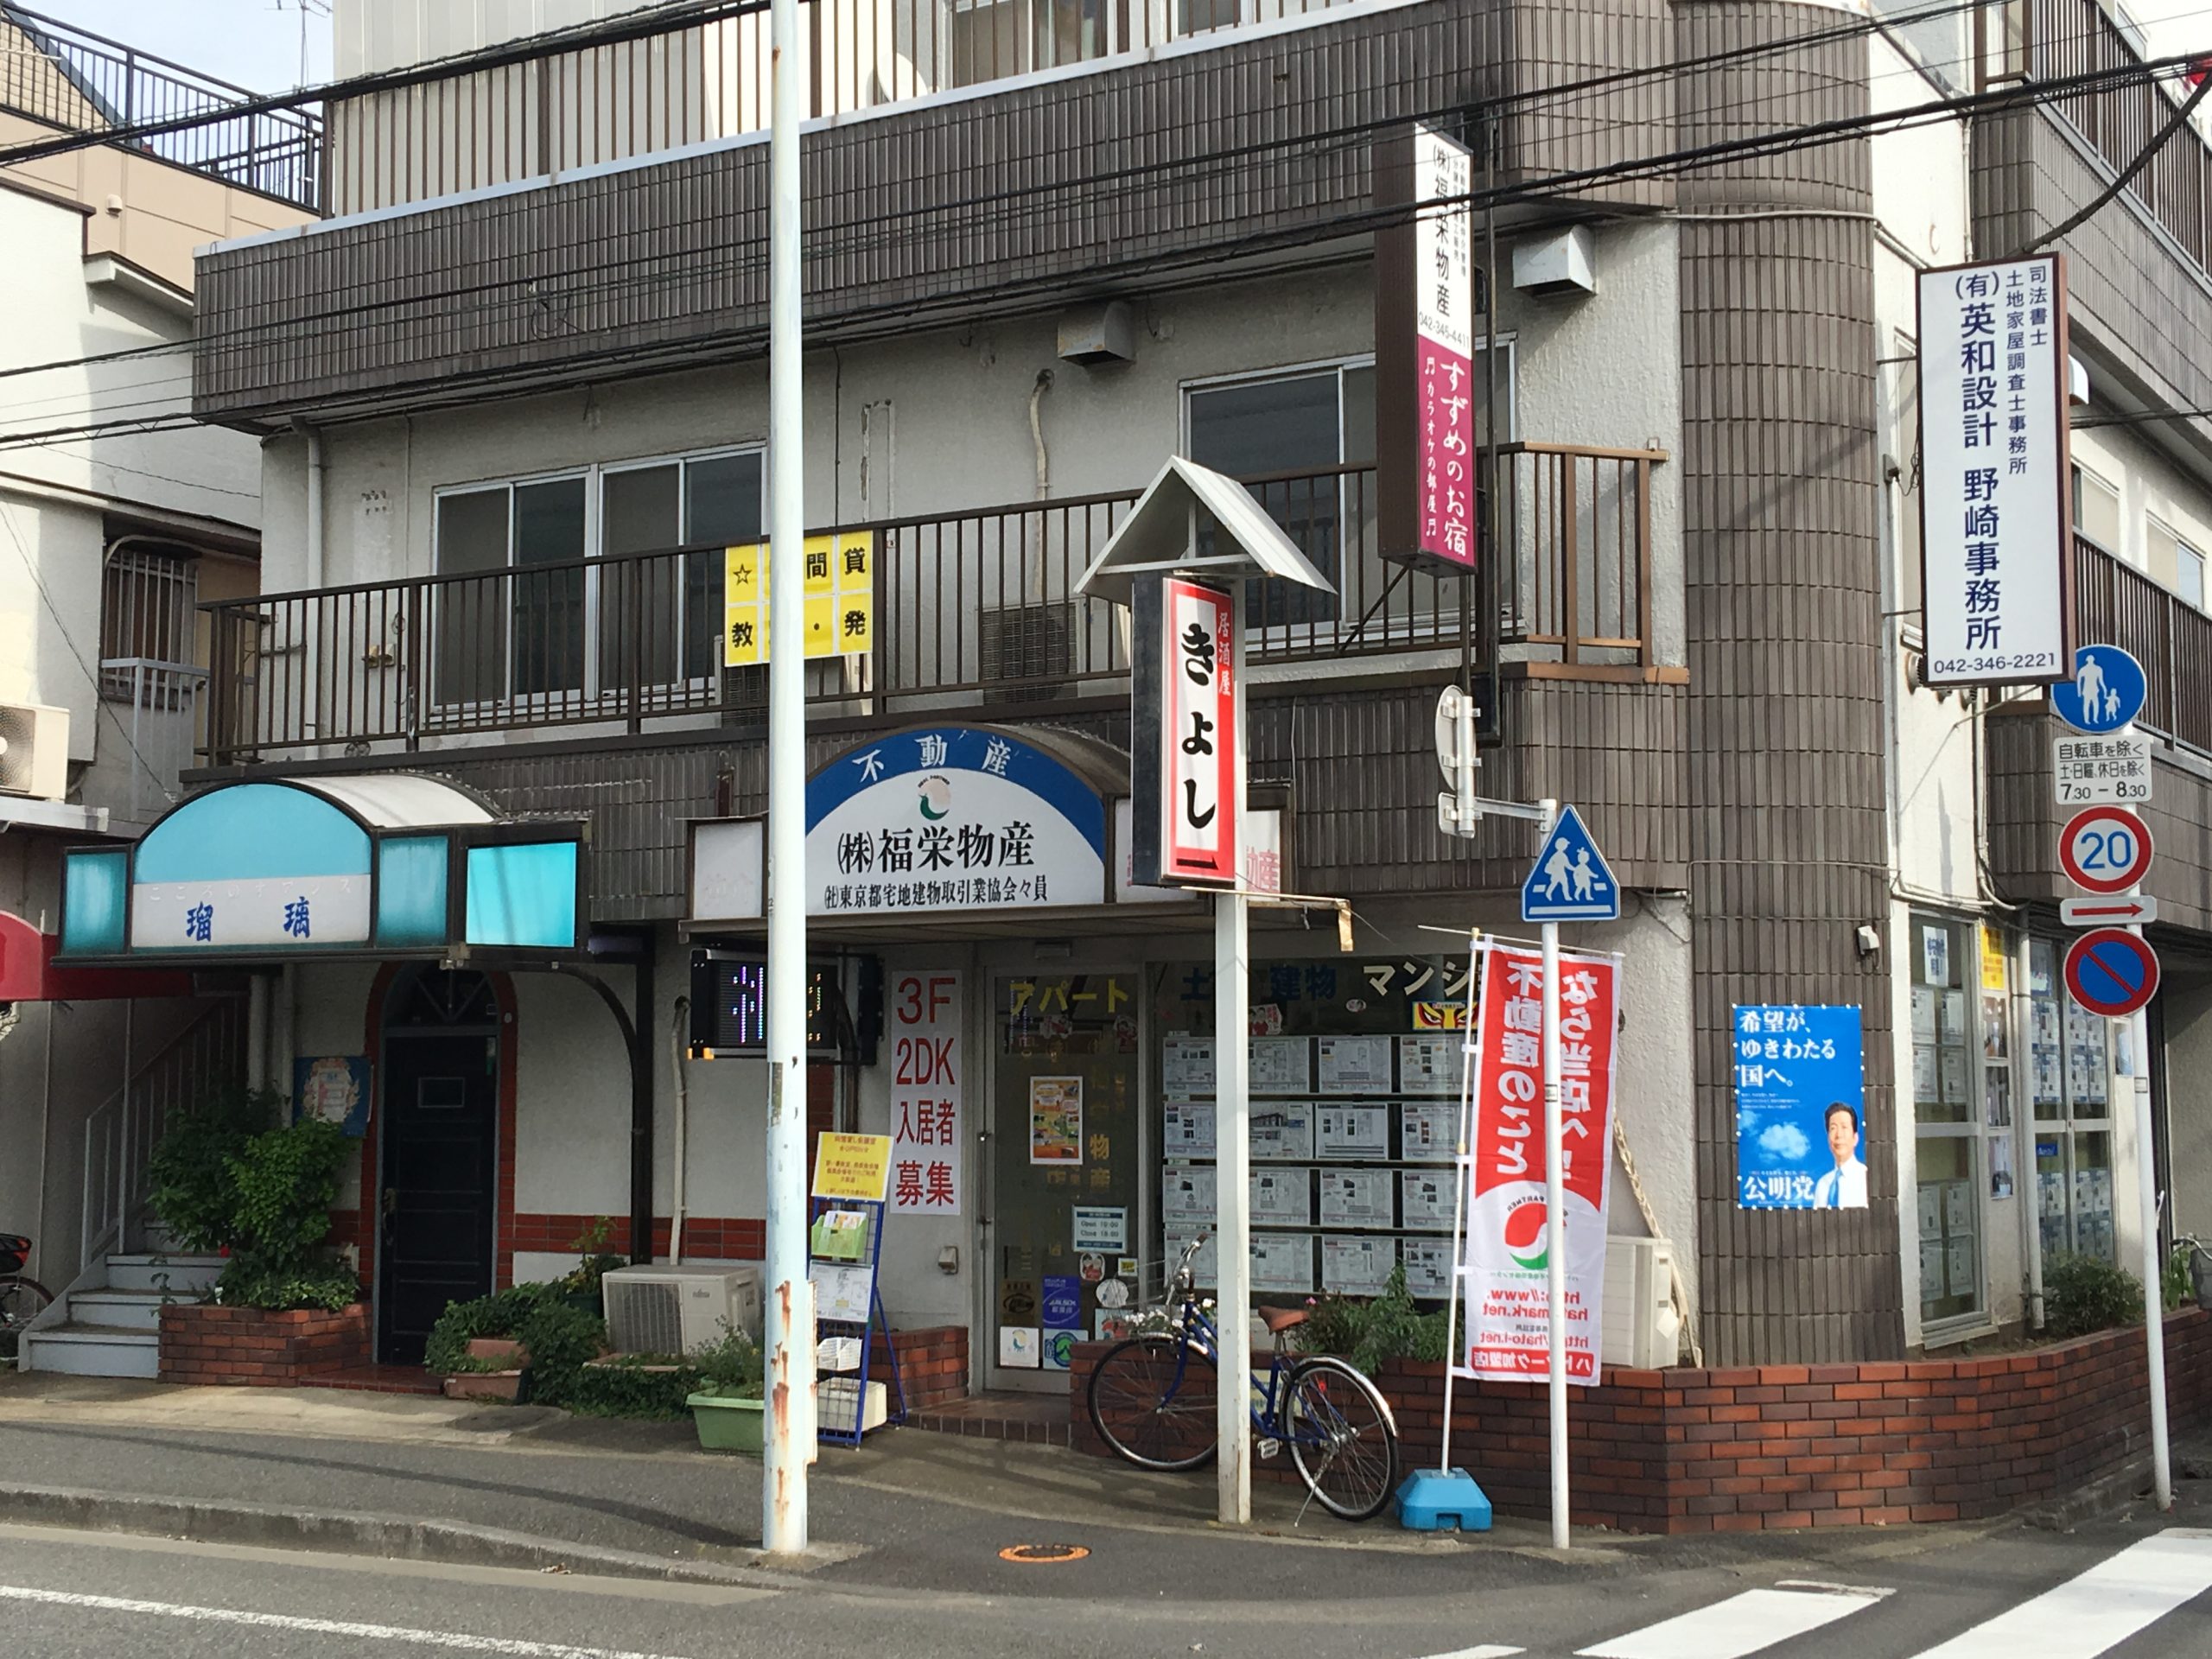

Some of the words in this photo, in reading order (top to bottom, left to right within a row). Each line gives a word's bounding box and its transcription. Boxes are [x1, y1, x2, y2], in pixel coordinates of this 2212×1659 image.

[2029, 264, 2049, 346] 司法書士
[1955, 270, 1999, 448] (有)英和設計
[2005, 270, 2028, 475] 土地家屋調査士事務所
[1441, 359, 1469, 556] すずめのお宿
[1963, 467, 2002, 651] 野崎事務所
[1217, 611, 1231, 696] 居酒屋
[1933, 652, 2056, 675] 042-346-2221
[1181, 622, 1217, 830] きよし
[852, 734, 1011, 783] 不動産
[2059, 741, 2144, 760] 自転車を除く
[837, 820, 1035, 874] (株)福栄物産
[2081, 830, 2132, 869] 20
[186, 896, 311, 942] 瑠璃
[897, 977, 956, 1024] 3F
[1009, 977, 1128, 1015] アパート
[896, 1037, 956, 1085] 2DK
[1741, 1038, 1836, 1059] ゆきわたる
[896, 1099, 956, 1146] 入居者
[896, 1160, 955, 1206] 募集
[1744, 1176, 1815, 1201] 公明党
